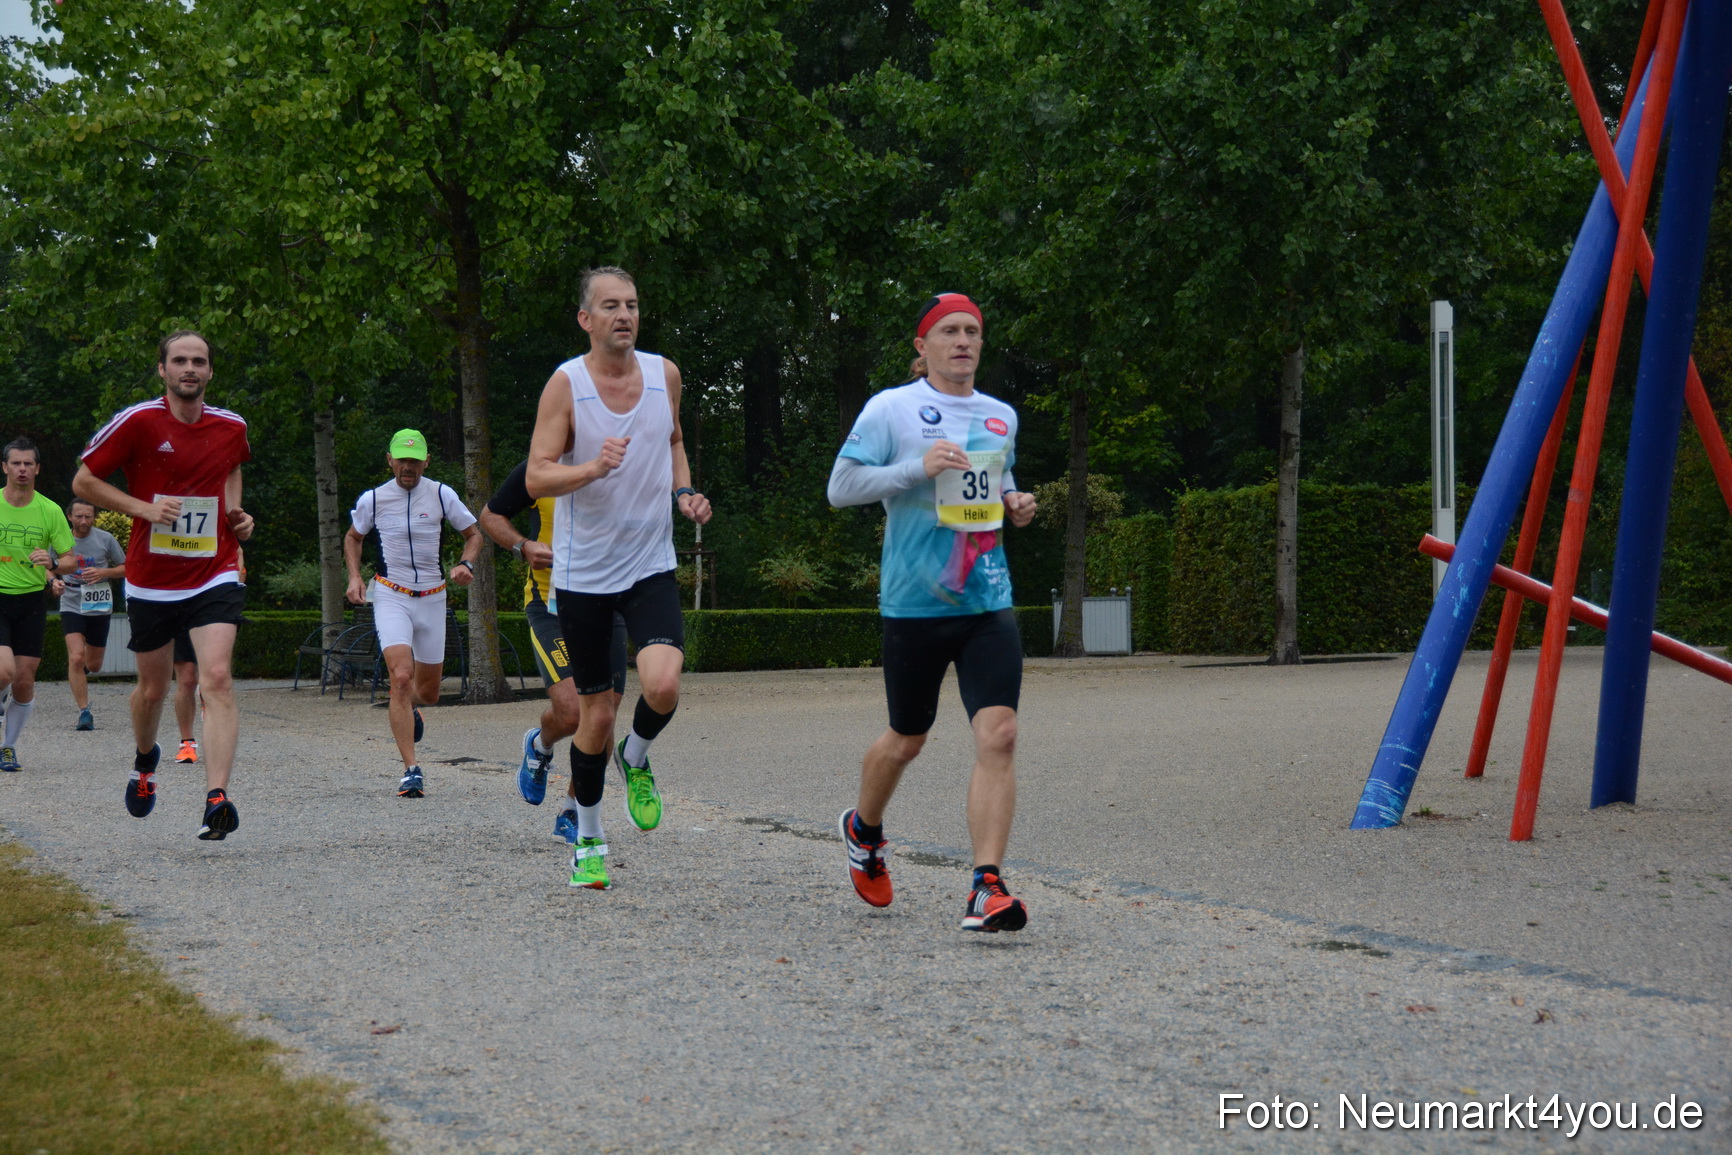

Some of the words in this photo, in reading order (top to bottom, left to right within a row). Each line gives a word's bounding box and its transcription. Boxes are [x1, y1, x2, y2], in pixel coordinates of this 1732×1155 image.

[963, 470, 989, 500] 39
[186, 499, 214, 508] BOCK
[964, 508, 988, 520] Heiko
[171, 538, 199, 549] Martin
[85, 589, 110, 602] 3026
